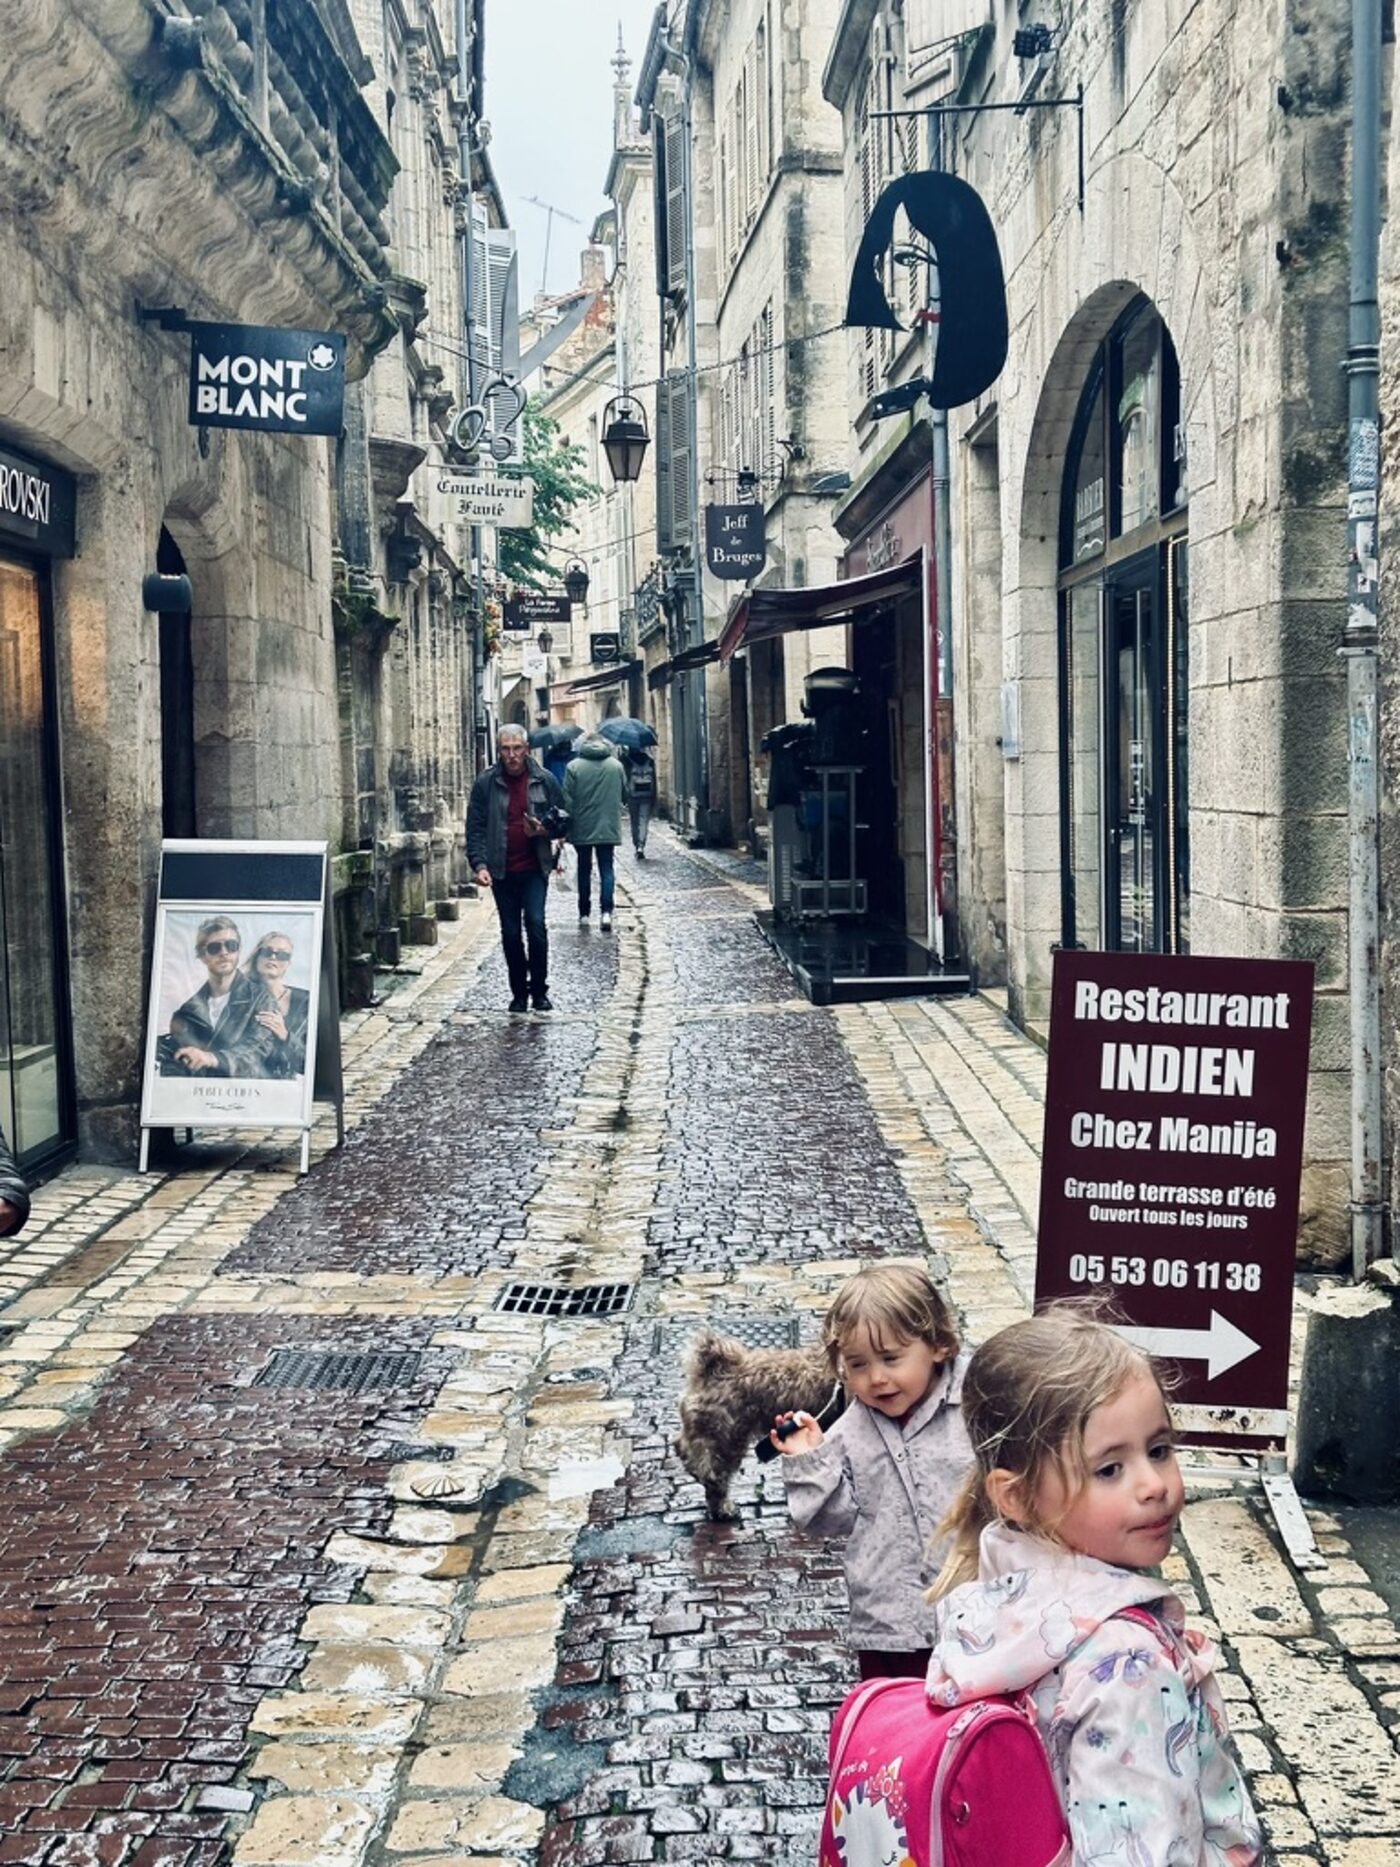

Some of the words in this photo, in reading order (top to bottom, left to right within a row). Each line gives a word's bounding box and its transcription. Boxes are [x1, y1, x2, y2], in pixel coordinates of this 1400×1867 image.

[198, 352, 307, 389] MONT
[197, 385, 307, 422] BLANC
[0, 464, 50, 524] ROVSKI
[437, 479, 527, 498] Coutellerie
[721, 514, 749, 531] Jeff
[730, 536, 742, 546] de
[712, 547, 762, 566] Bruges
[1074, 980, 1290, 1029] Restaurant
[1100, 1042, 1255, 1097] INDIEN
[1070, 1112, 1152, 1150] Chez
[1159, 1117, 1277, 1158] Manija
[1064, 1177, 1135, 1200] Grande
[1139, 1182, 1223, 1206] terrasse
[1227, 1186, 1276, 1209] d'été
[1089, 1205, 1140, 1223] Ouvert
[1143, 1208, 1177, 1225] tous
[1180, 1209, 1204, 1227] les
[1206, 1211, 1248, 1229] jours
[1069, 1254, 1104, 1282] 05
[1111, 1256, 1146, 1286] 53
[1153, 1259, 1188, 1288] 06
[1194, 1261, 1219, 1289] 11
[1226, 1263, 1261, 1292] 38
